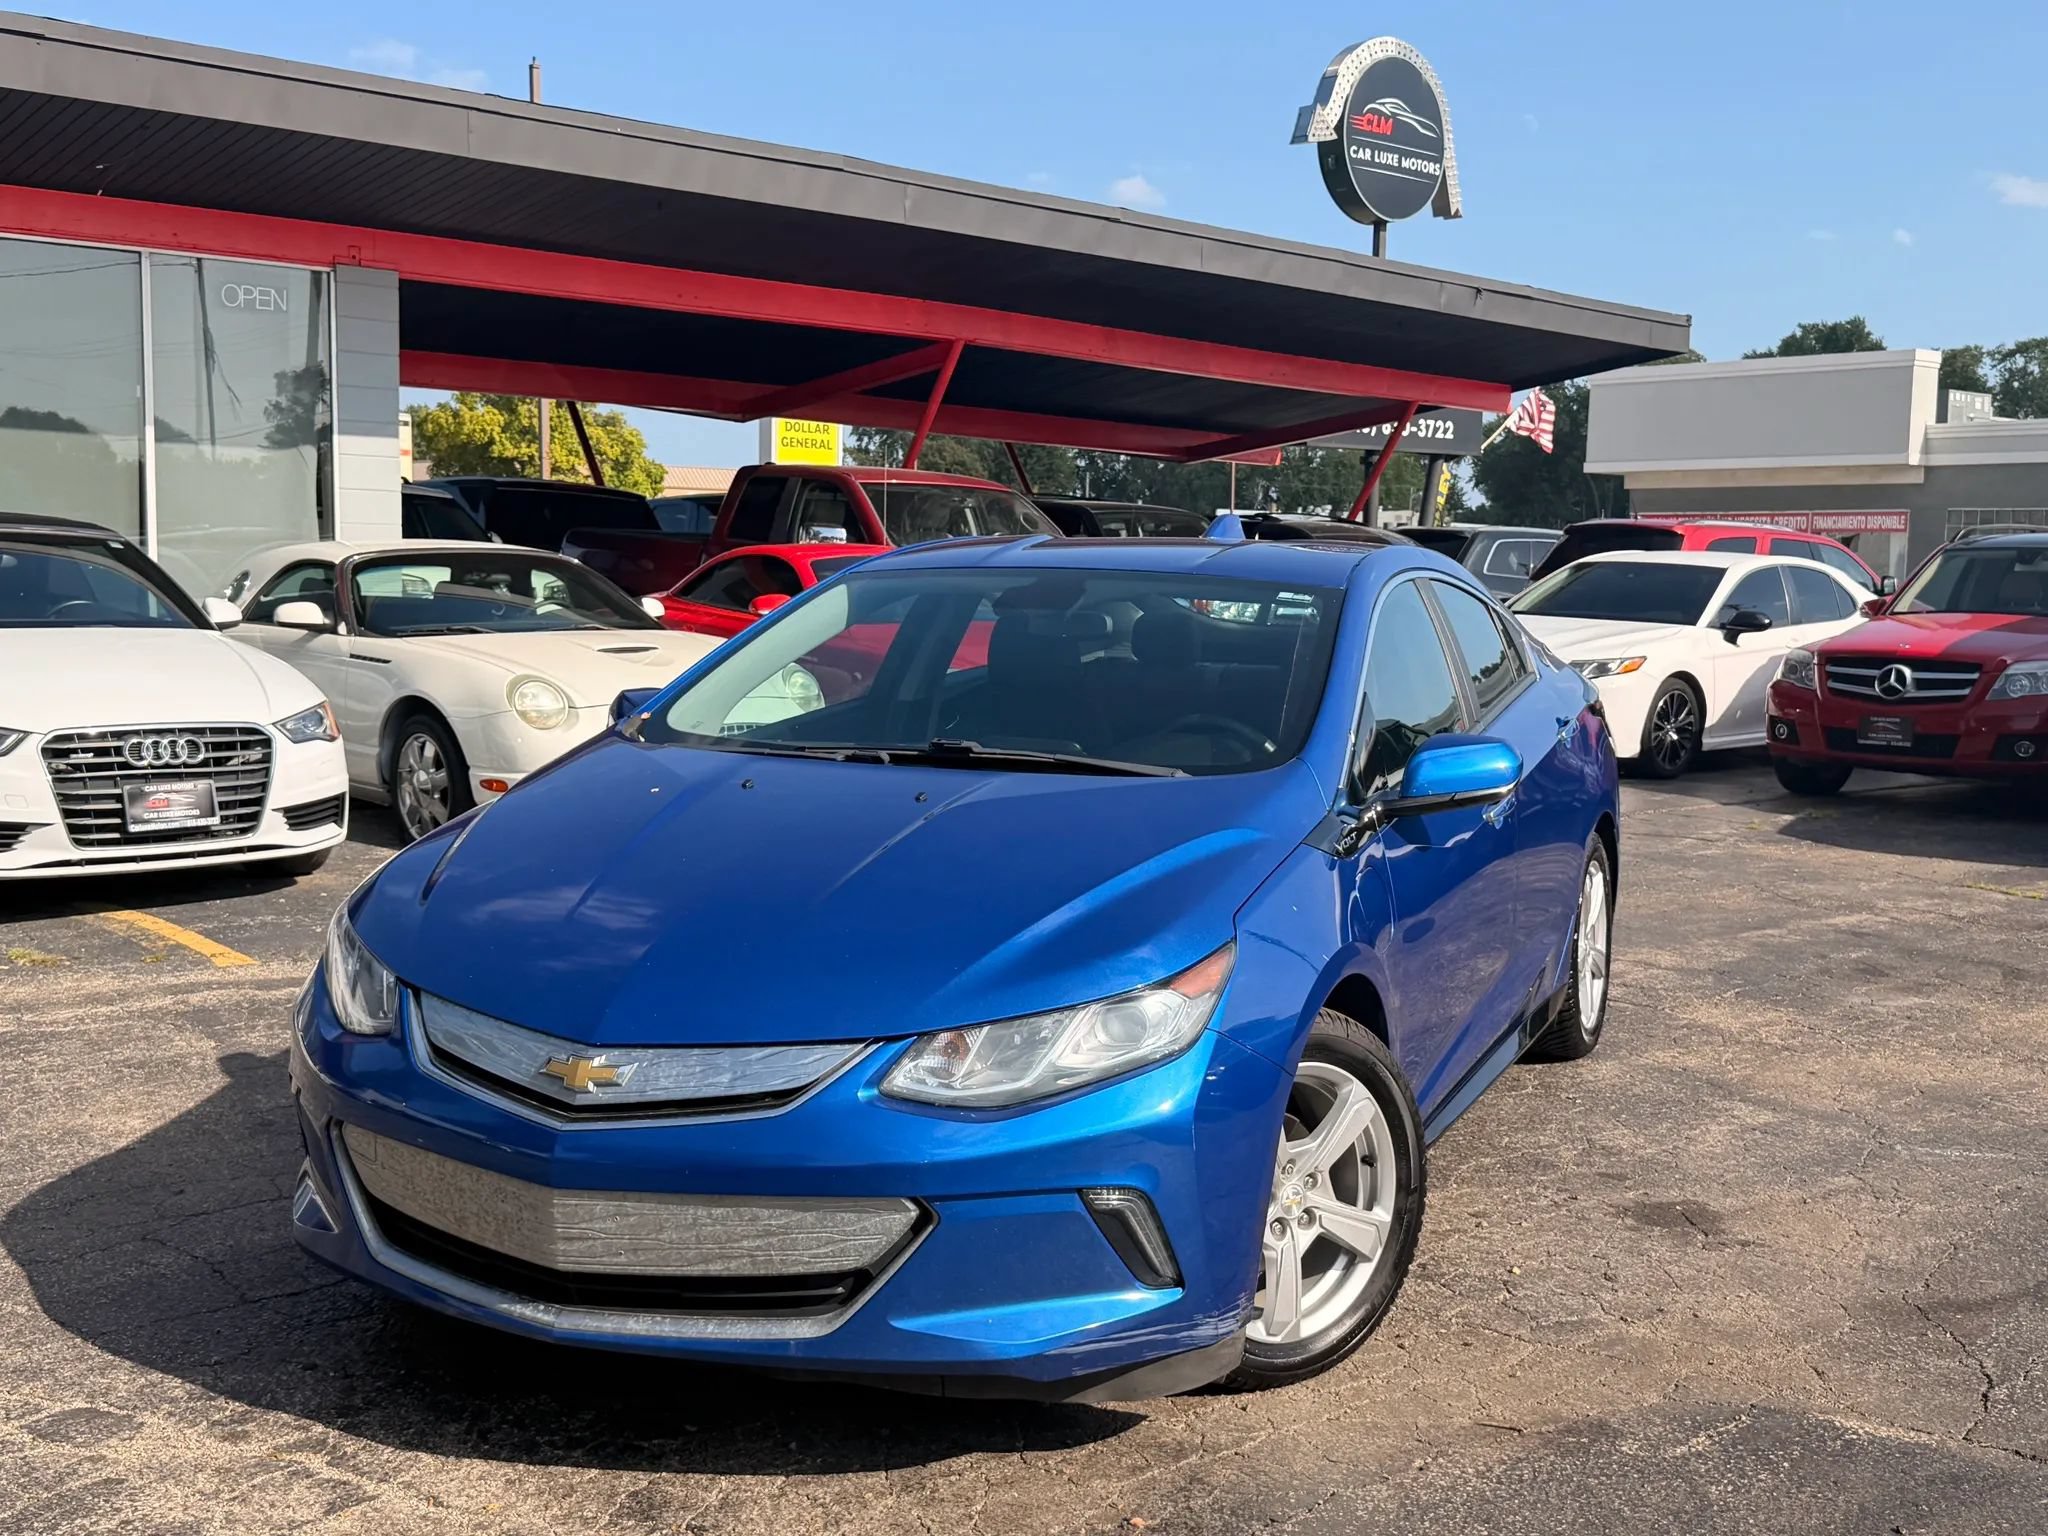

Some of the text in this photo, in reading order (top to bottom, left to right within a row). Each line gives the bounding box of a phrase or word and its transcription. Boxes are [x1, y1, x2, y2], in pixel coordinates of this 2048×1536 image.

[1362, 113, 1393, 135] CLM
[1350, 145, 1440, 176] CAR LUXE MOTORS
[221, 283, 287, 311] OPEN
[785, 421, 830, 435] DOLLAR
[781, 436, 832, 450] GENERAL
[1813, 515, 1905, 529] FINANCIAMIENTO DISPONIBLE
[143, 811, 158, 819] CAR
[1333, 831, 1357, 853] VOLT
